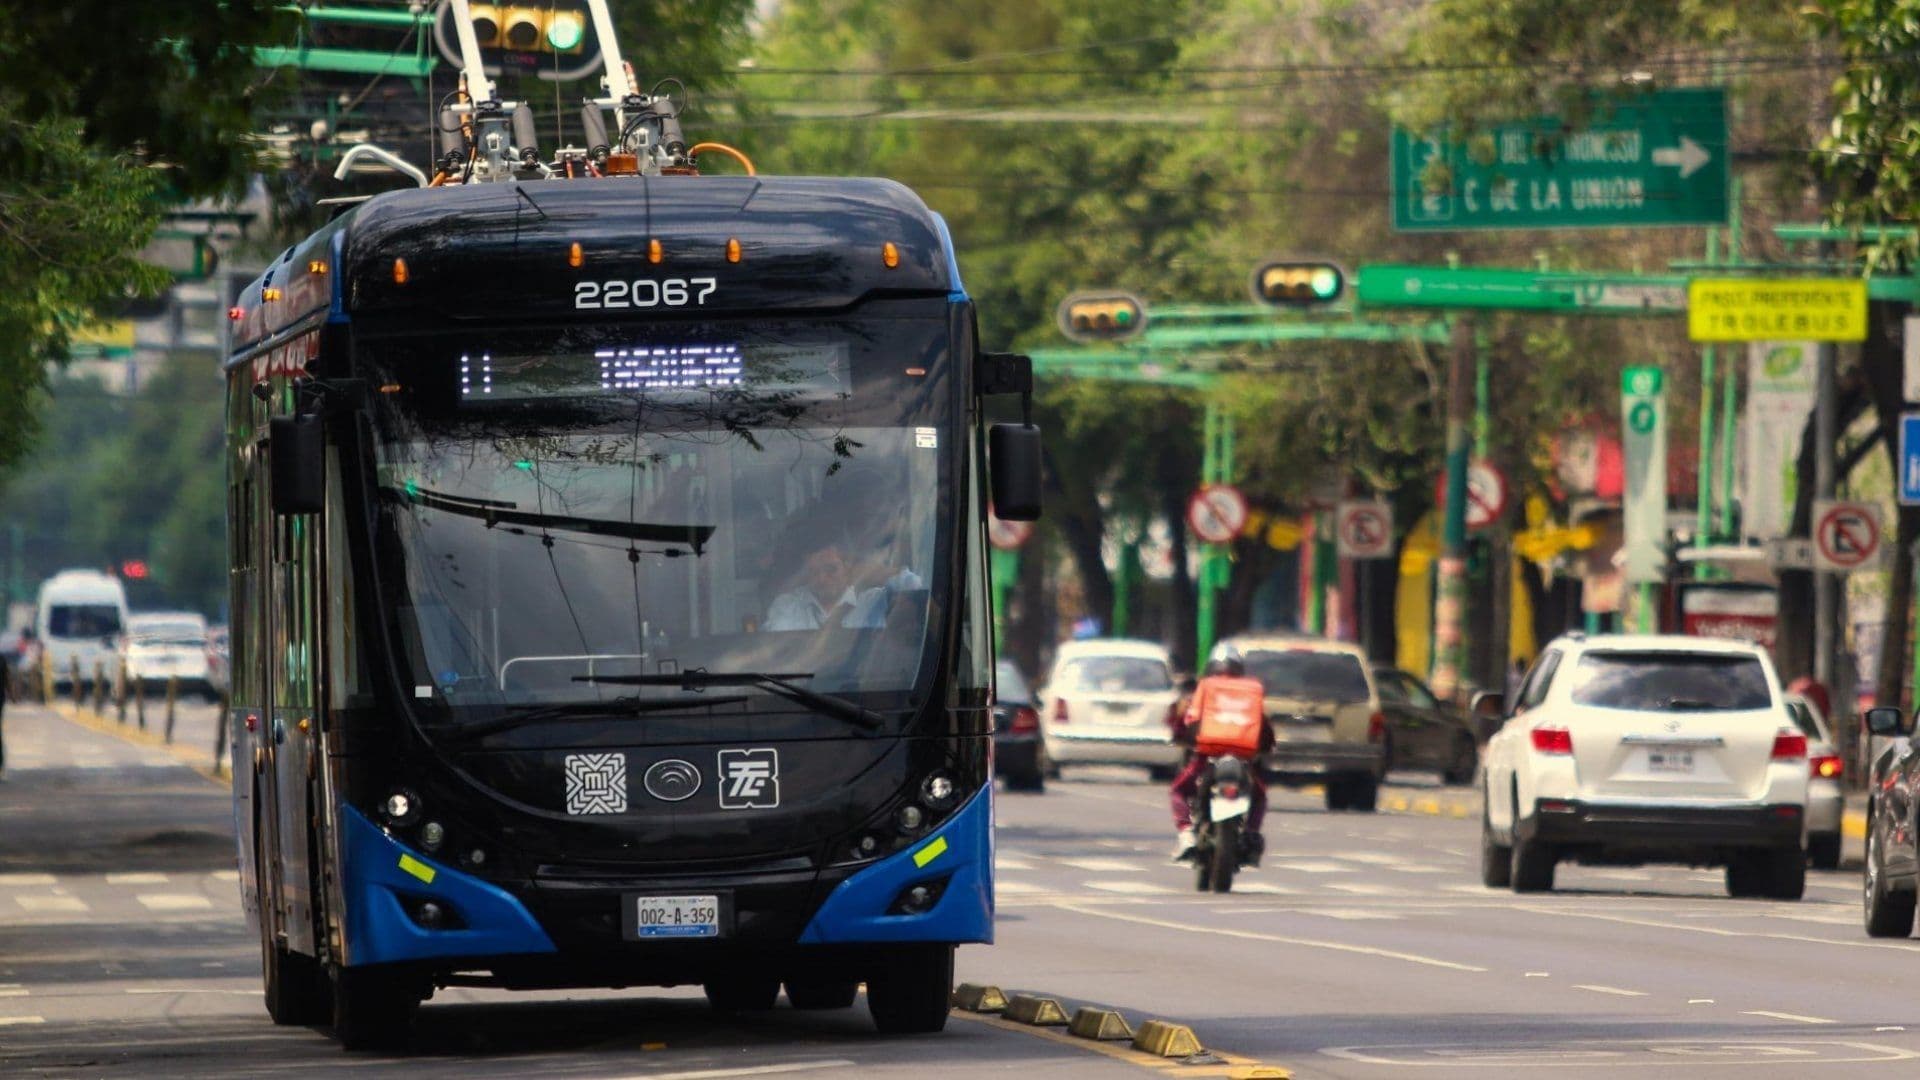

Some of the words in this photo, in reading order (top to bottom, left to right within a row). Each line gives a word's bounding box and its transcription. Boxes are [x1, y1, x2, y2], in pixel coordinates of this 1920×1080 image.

[1464, 178, 1479, 212] C
[1530, 178, 1561, 211] LA
[575, 277, 716, 309] 22067
[1709, 313, 1849, 332] TROLEBUS
[641, 907, 716, 925] 002-A-359
